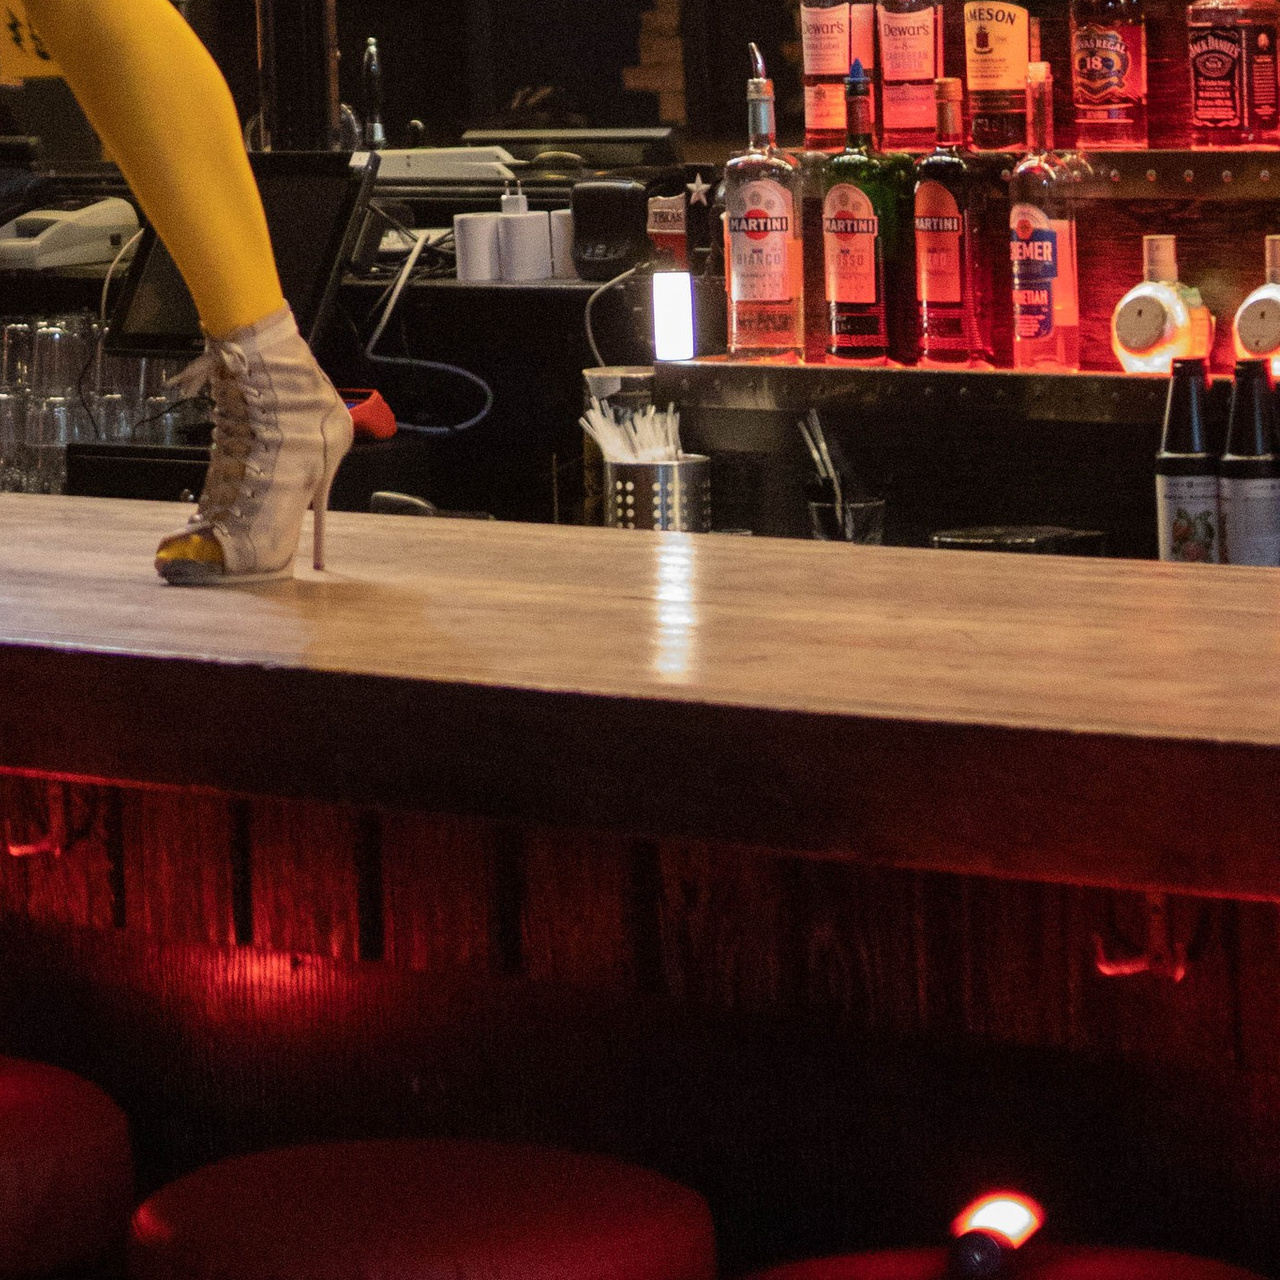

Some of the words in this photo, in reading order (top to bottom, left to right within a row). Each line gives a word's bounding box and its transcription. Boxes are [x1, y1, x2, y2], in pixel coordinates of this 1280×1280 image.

[883, 23, 930, 37] Dewar's
[1086, 56, 1102, 71] 18
[730, 217, 787, 232] MARTINI
